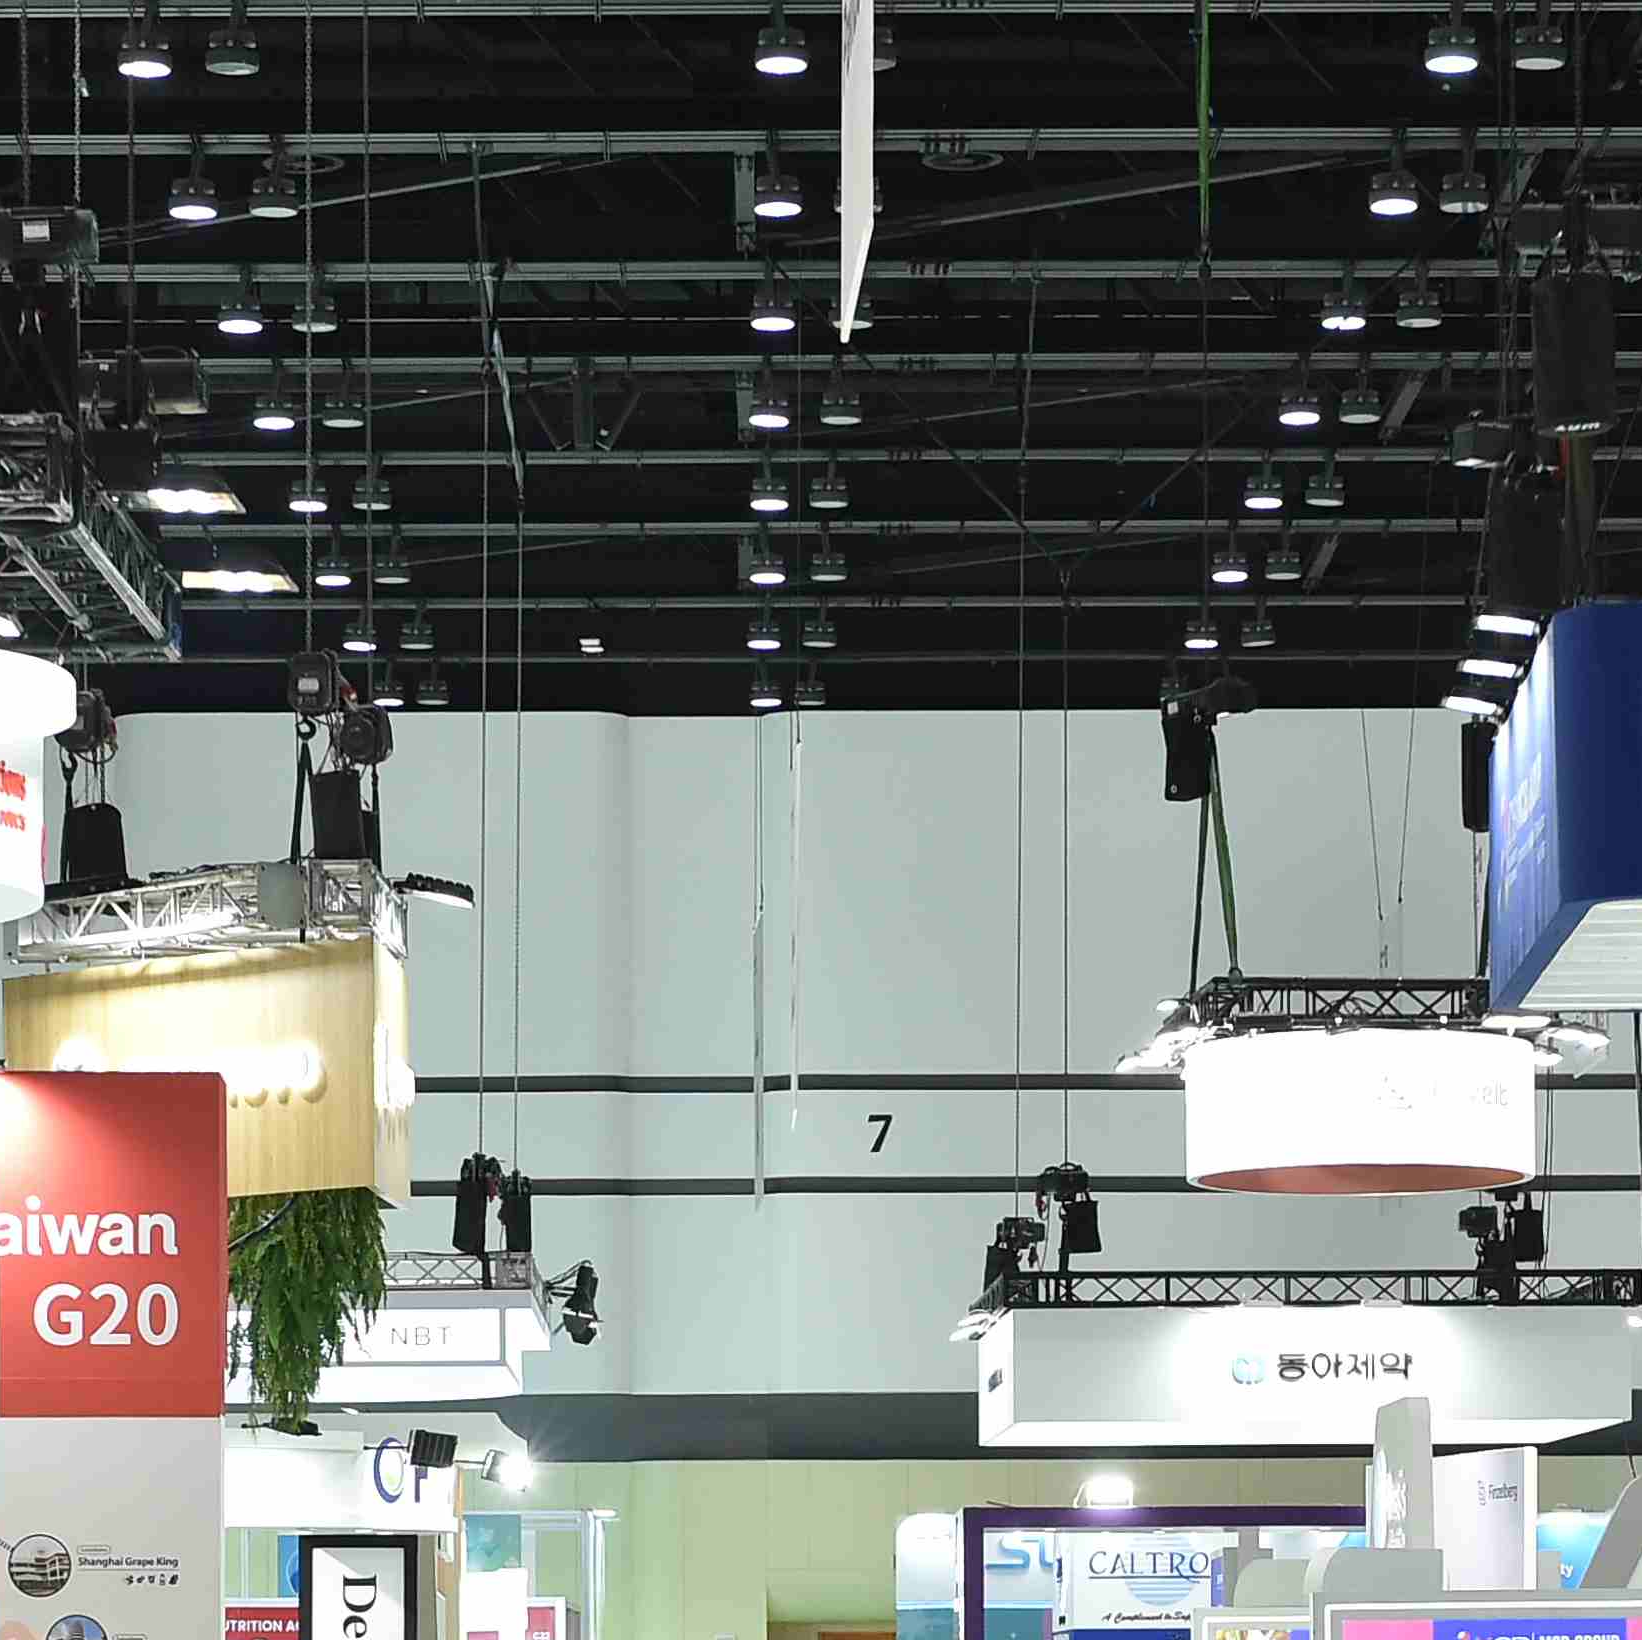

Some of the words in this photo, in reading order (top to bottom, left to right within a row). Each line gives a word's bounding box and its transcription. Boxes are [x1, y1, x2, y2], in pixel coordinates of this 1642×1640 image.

[867, 1113, 893, 1154] 7
[32, 1281, 180, 1347] G20
[389, 1325, 452, 1346] NBT
[1277, 1352, 1413, 1382] 동아제약
[77, 1556, 124, 1569] Shanghai
[125, 1557, 155, 1569] Grape
[156, 1556, 179, 1568] King
